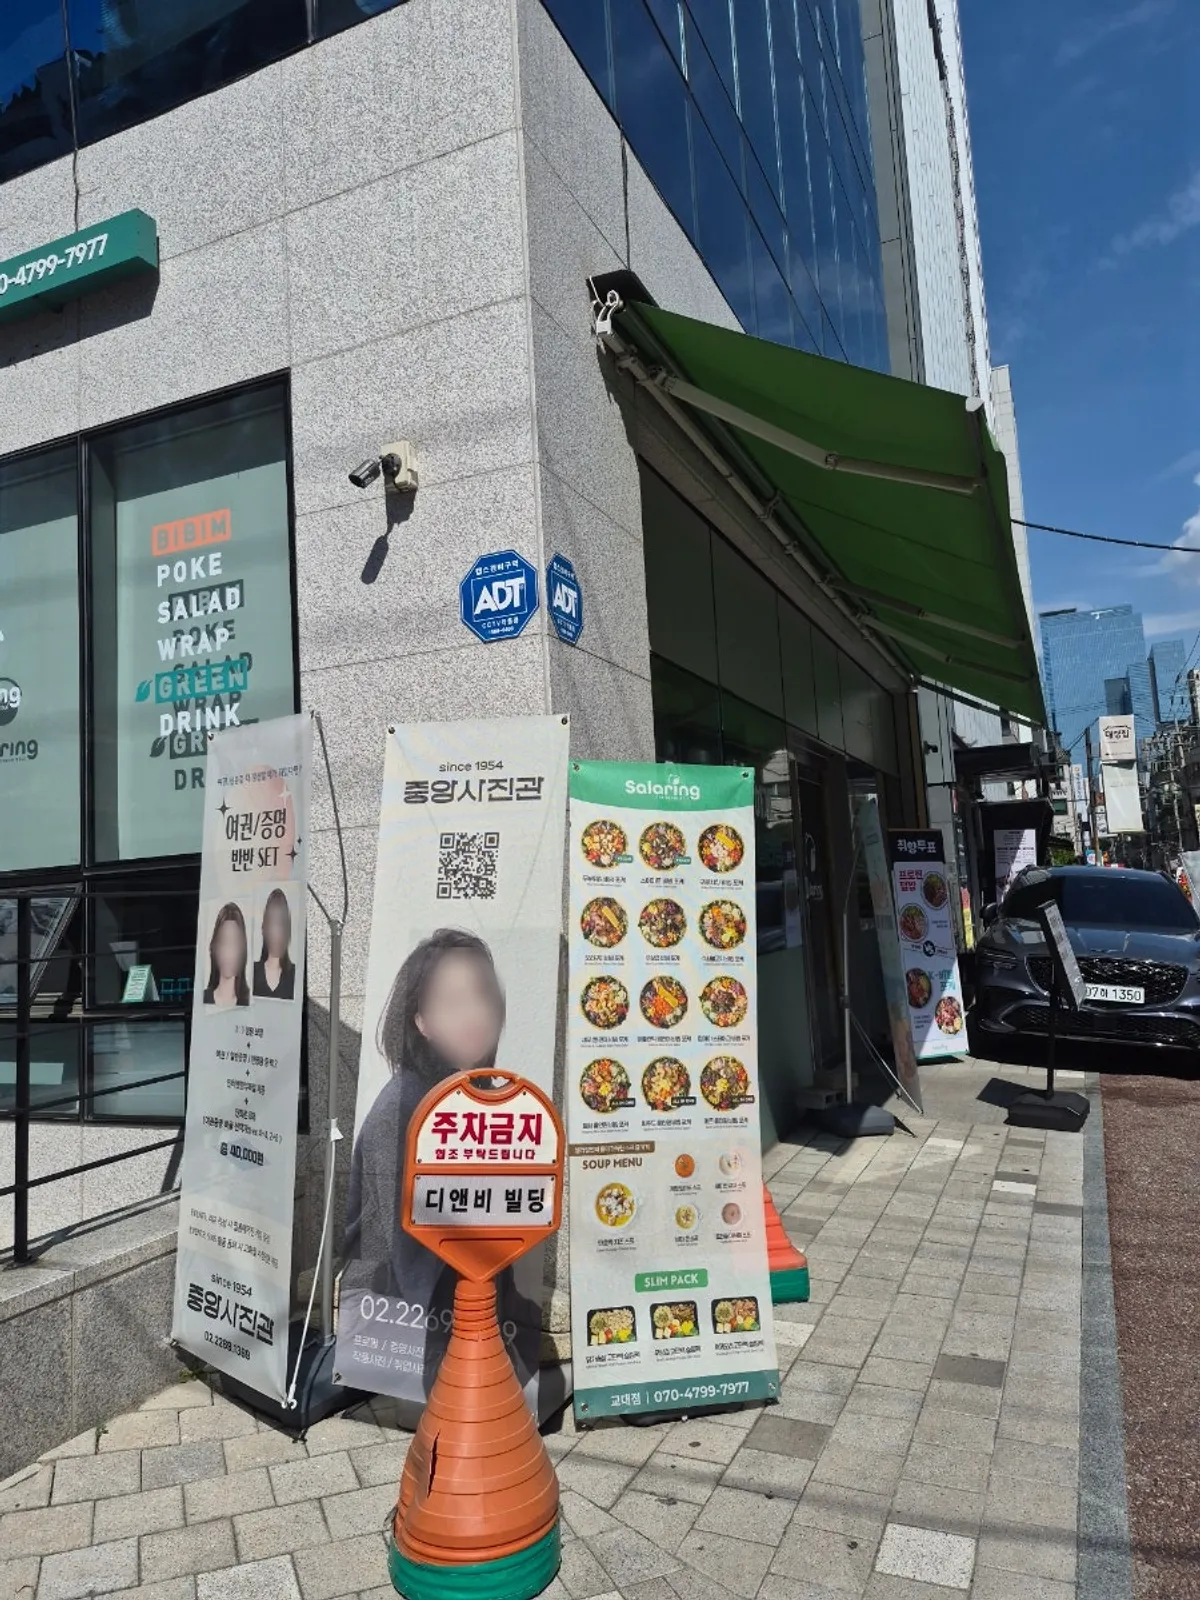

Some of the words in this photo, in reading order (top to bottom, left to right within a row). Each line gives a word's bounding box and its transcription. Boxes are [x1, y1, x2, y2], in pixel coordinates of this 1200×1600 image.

[156, 517, 227, 549] BIBIM
[157, 552, 223, 587] POKE
[157, 588, 241, 624] SALAD
[473, 577, 525, 615] ADT
[553, 582, 578, 619] ADT
[157, 628, 230, 661] WRAP
[159, 668, 244, 699] GREEN
[160, 703, 241, 737] DRINK
[439, 761, 472, 772] since
[475, 760, 504, 771] 1954
[403, 776, 545, 804] 중앙사진관
[625, 777, 701, 800] Salaring
[226, 808, 287, 841] 여권/증명
[232, 847, 254, 872] 반반
[258, 846, 280, 868] SET
[1112, 988, 1142, 1002] 1350
[431, 1112, 543, 1146] 주차금지
[435, 1148, 459, 1161] 협조
[463, 1149, 536, 1161] 부탁드립니다
[582, 1159, 611, 1170] SOUP
[614, 1157, 643, 1169] MENU
[425, 1187, 492, 1213] 디앤비
[505, 1188, 546, 1213] 빌딩
[210, 1273, 232, 1290] since
[232, 1281, 253, 1297] 1954
[644, 1275, 668, 1287] SLIM
[671, 1273, 698, 1286] PACK
[187, 1282, 275, 1346] 중앙사진관
[610, 1392, 642, 1408] 교대점
[653, 1380, 750, 1404] 070-4799-7977
